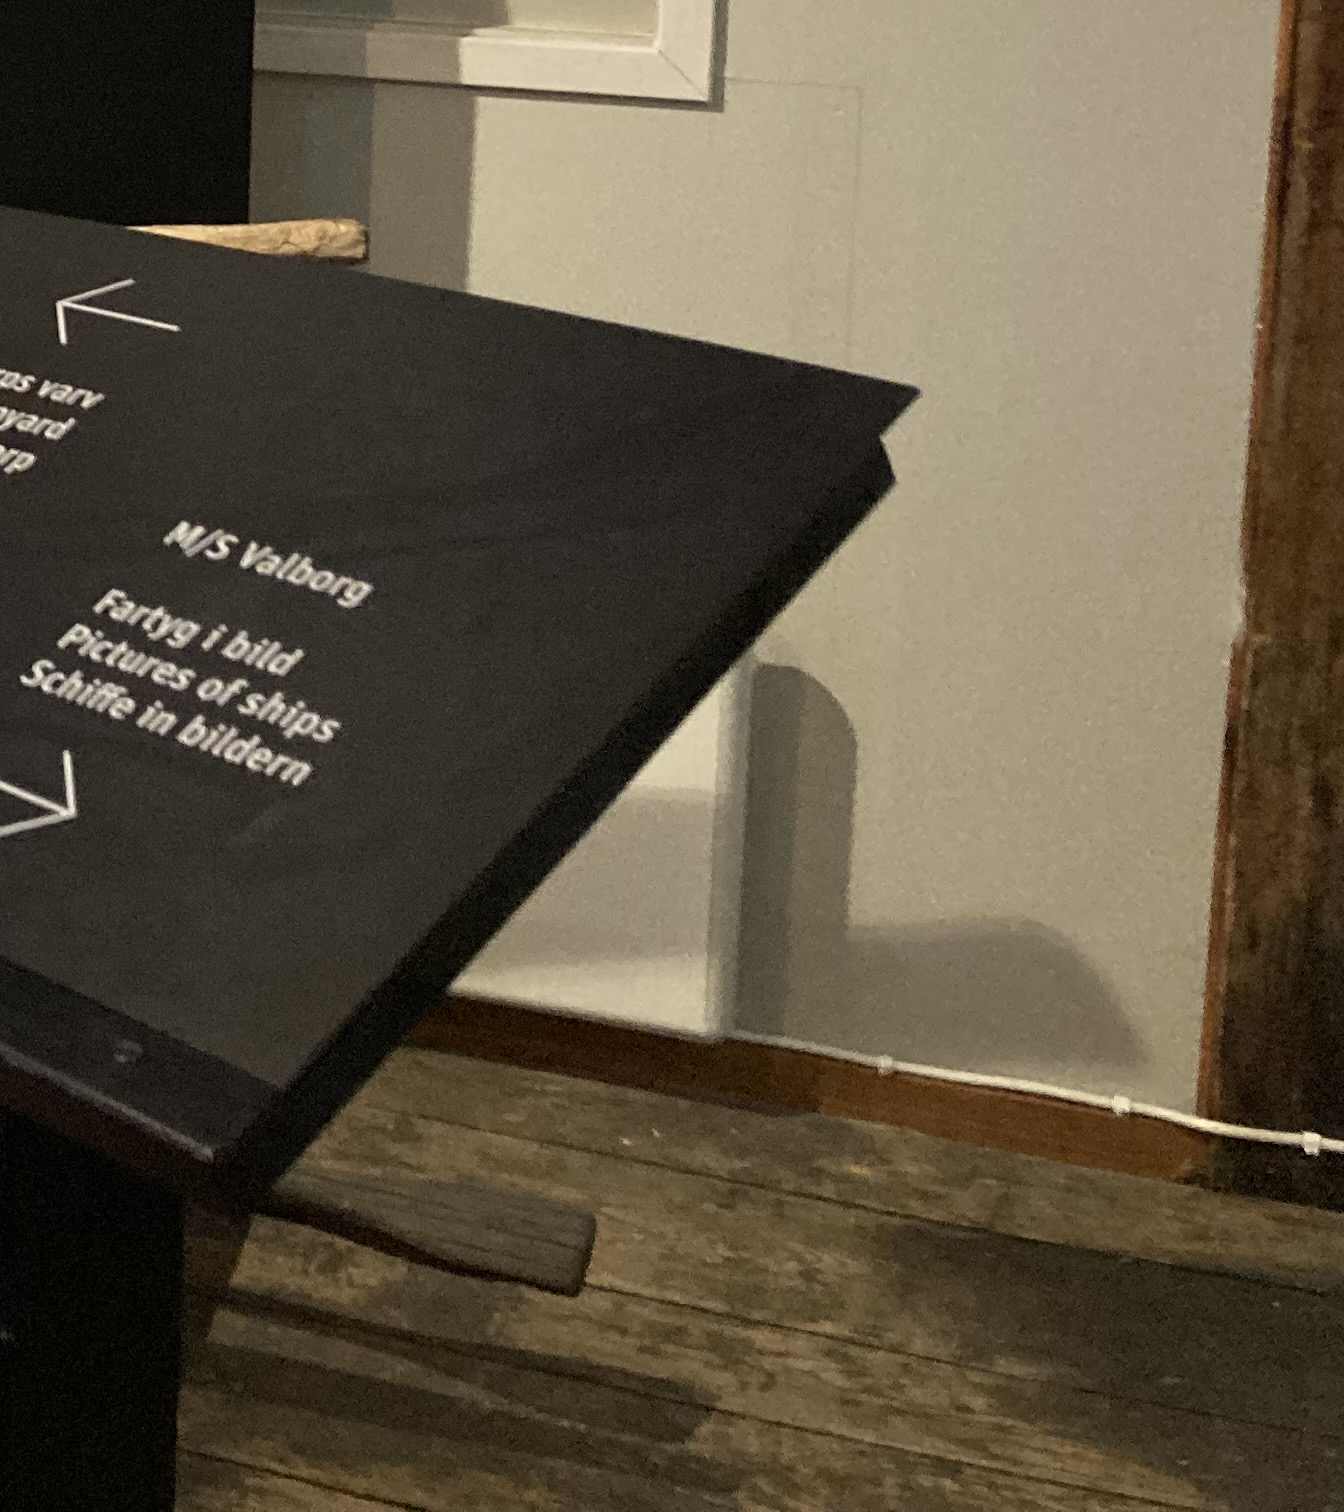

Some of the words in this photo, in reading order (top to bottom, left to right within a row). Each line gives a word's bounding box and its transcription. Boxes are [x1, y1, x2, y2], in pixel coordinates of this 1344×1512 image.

[36, 377, 106, 409] varv
[163, 520, 239, 560] M/S
[239, 541, 375, 609] Valborg
[92, 588, 201, 649] Fartyg
[201, 624, 228, 651] i
[222, 630, 306, 677] bild
[19, 658, 137, 720] Schiffe
[135, 700, 179, 737] in
[177, 714, 314, 787] bildern
[57, 623, 196, 692] Pictures
[196, 677, 250, 706] of
[237, 691, 342, 743] ships
